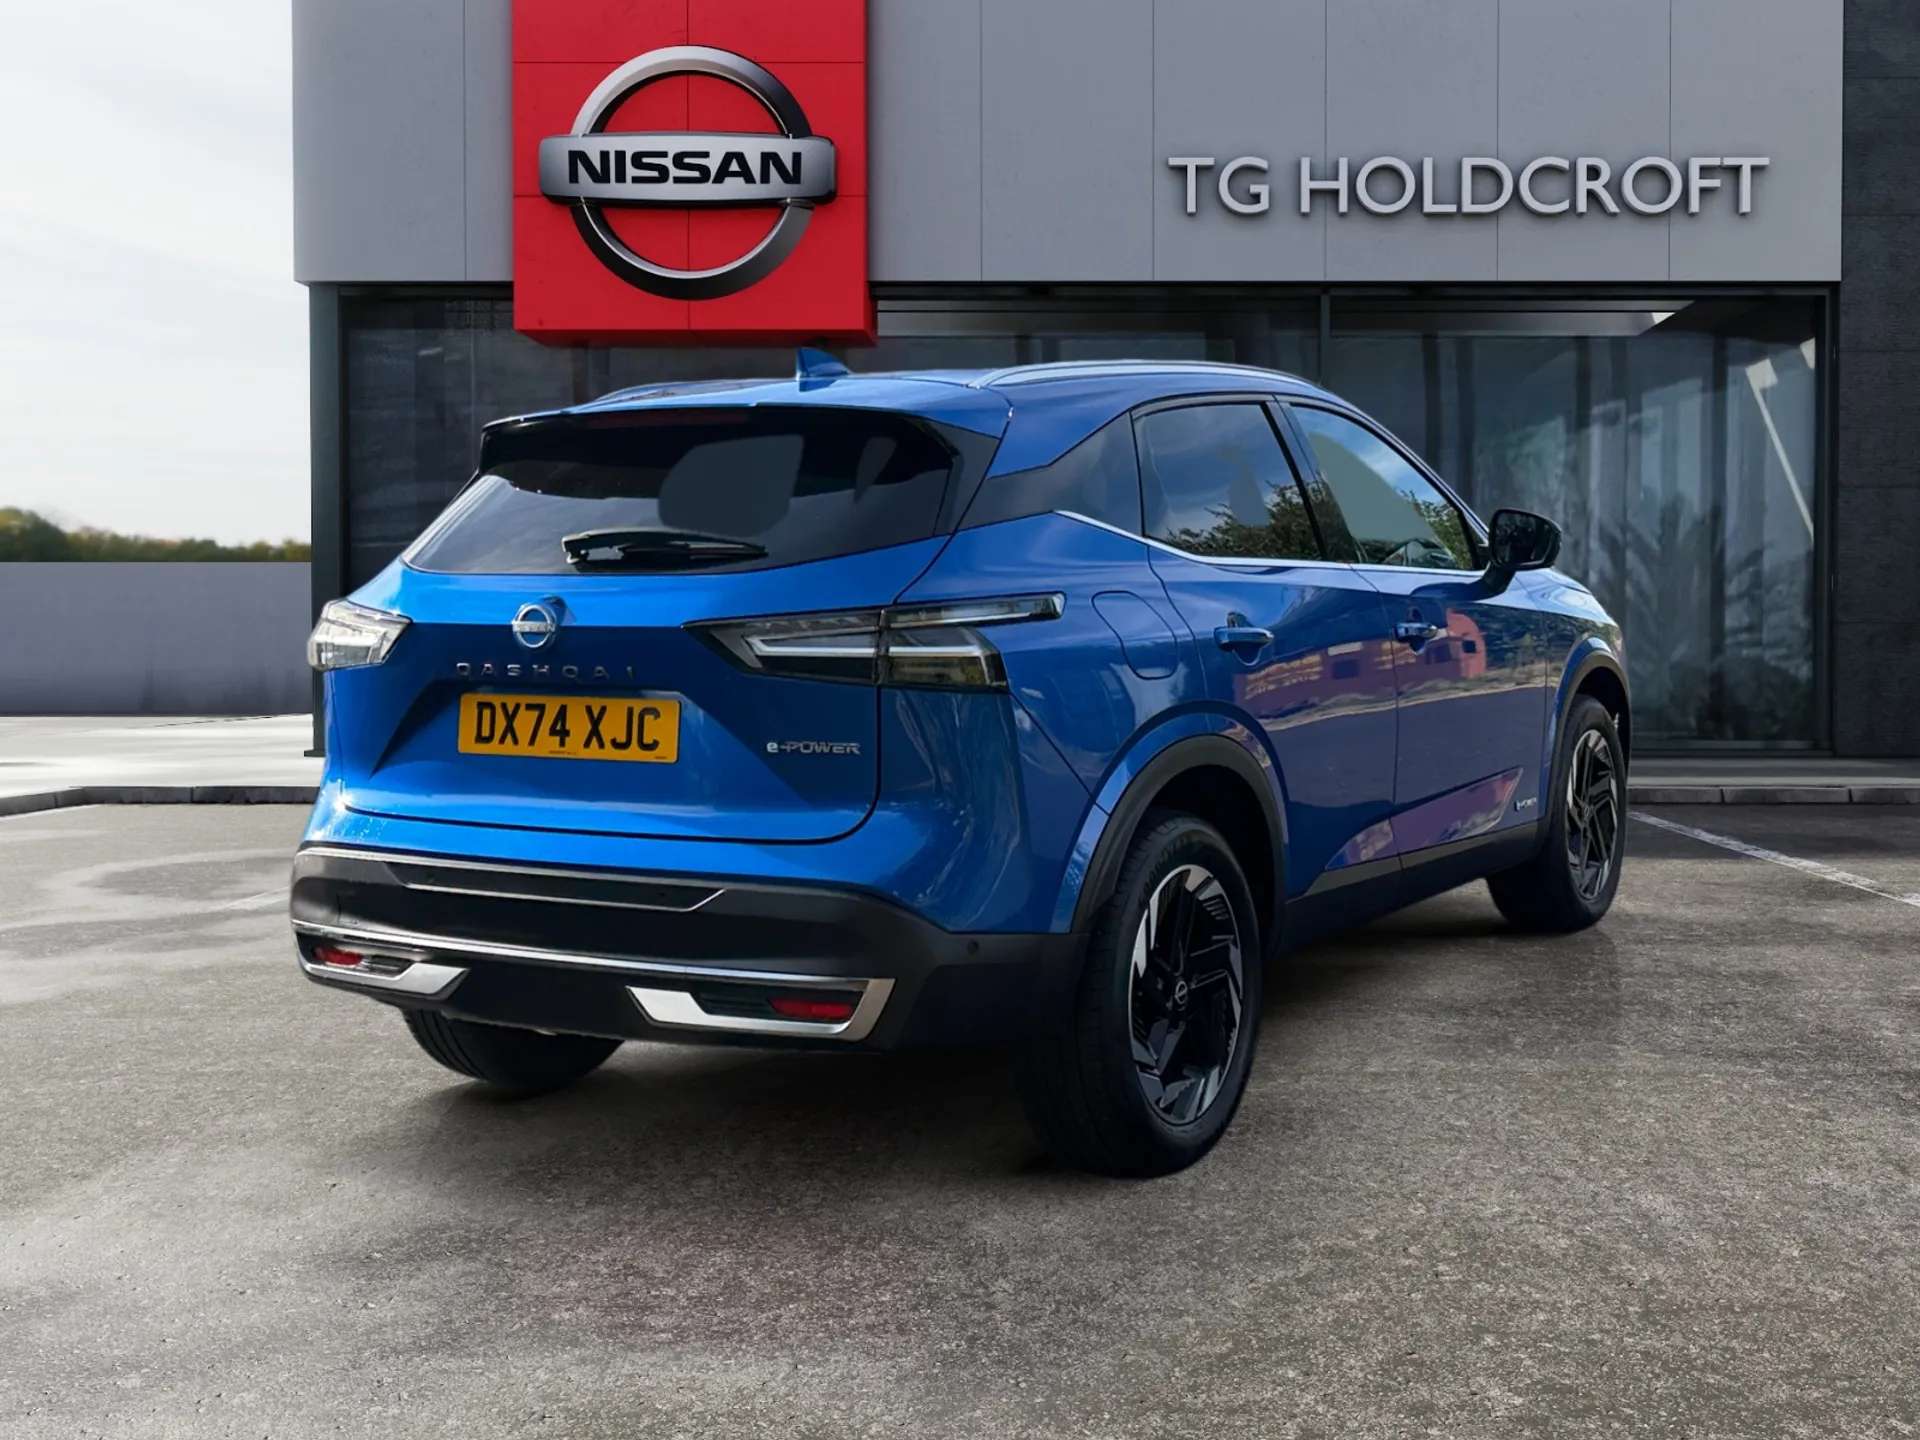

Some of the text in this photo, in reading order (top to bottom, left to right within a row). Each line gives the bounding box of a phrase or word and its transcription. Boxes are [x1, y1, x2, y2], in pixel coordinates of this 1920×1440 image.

[567, 150, 802, 184] NISSAN
[1168, 156, 1770, 215] TG HOLDCROFT
[474, 701, 660, 751] DX74 XJC
[766, 741, 860, 755] e-POWER
